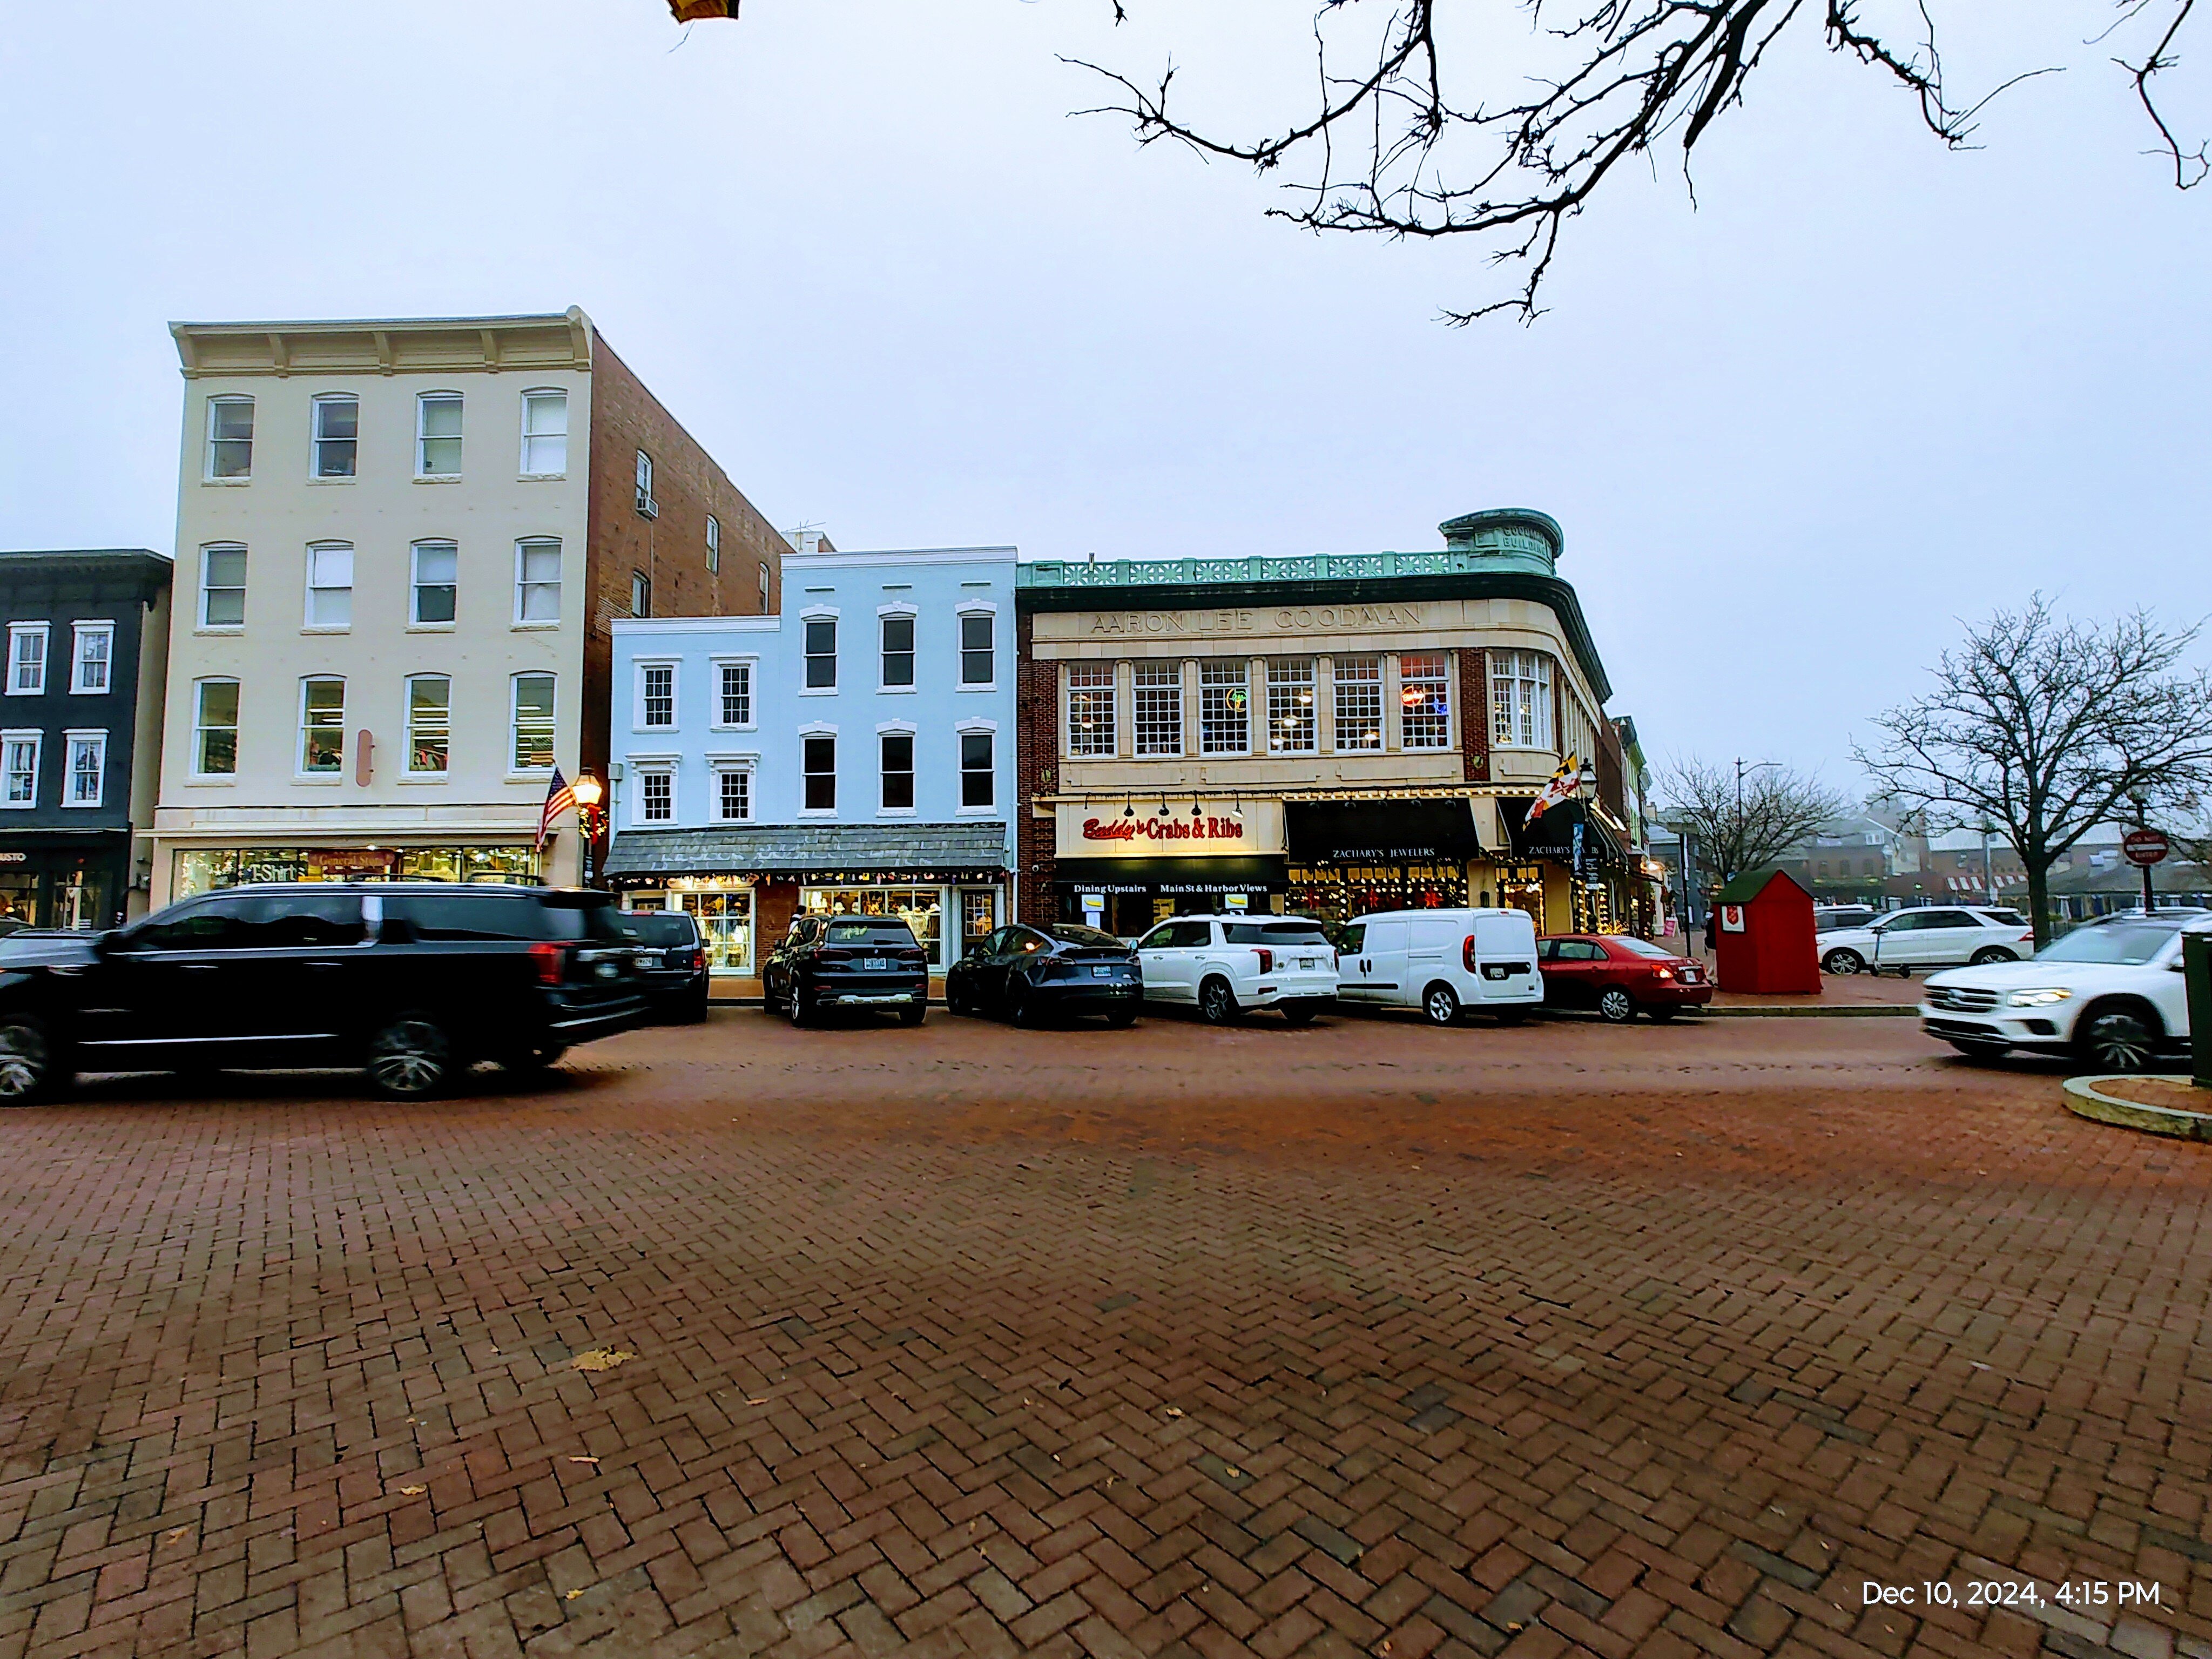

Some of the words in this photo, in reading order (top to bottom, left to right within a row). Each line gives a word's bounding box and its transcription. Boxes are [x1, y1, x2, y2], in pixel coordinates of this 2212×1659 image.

[1503, 525, 1545, 544] GOODMAN
[1503, 537, 1546, 556] BUILDING
[1091, 613, 1184, 633] AARON
[1199, 612, 1253, 631] LEE
[1275, 604, 1421, 628] GOODMAN
[1083, 818, 1146, 841] Buddy's
[1146, 817, 1189, 839] Crabs
[1192, 817, 1205, 838] &
[1208, 817, 1243, 838] Ribs
[1333, 849, 1384, 858] ZACHARY'S
[1390, 848, 1435, 858] JEWELERS
[1529, 846, 1570, 854] ZACHARY'S
[1074, 885, 1107, 894] Dining
[1107, 885, 1147, 894] Upstairs
[1160, 884, 1184, 893] Main
[1185, 884, 1195, 893] St
[1196, 885, 1203, 893] &
[1204, 884, 1239, 893] Harbor
[1239, 884, 1267, 892] Views
